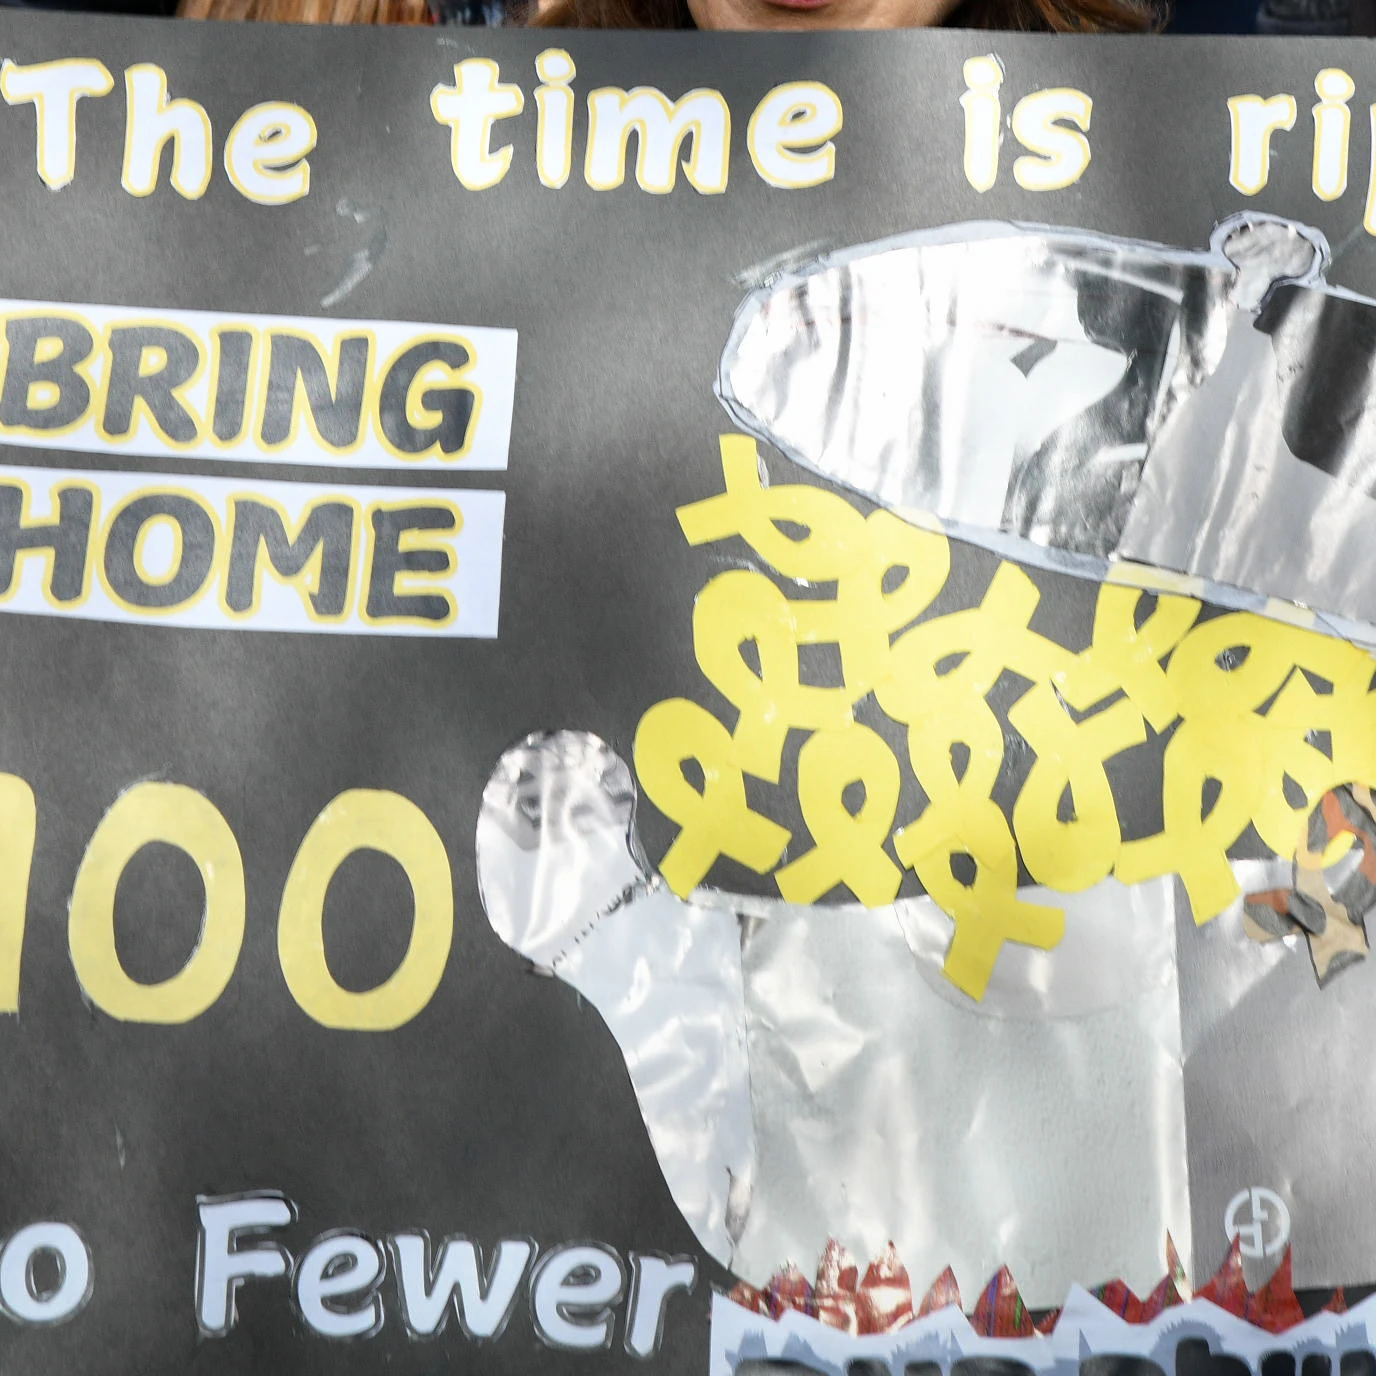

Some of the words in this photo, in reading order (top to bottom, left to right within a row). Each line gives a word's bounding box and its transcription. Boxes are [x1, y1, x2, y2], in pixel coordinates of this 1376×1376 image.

[429, 47, 846, 199] time
[960, 53, 1095, 194] is
[194, 1189, 700, 1359] Fewer
